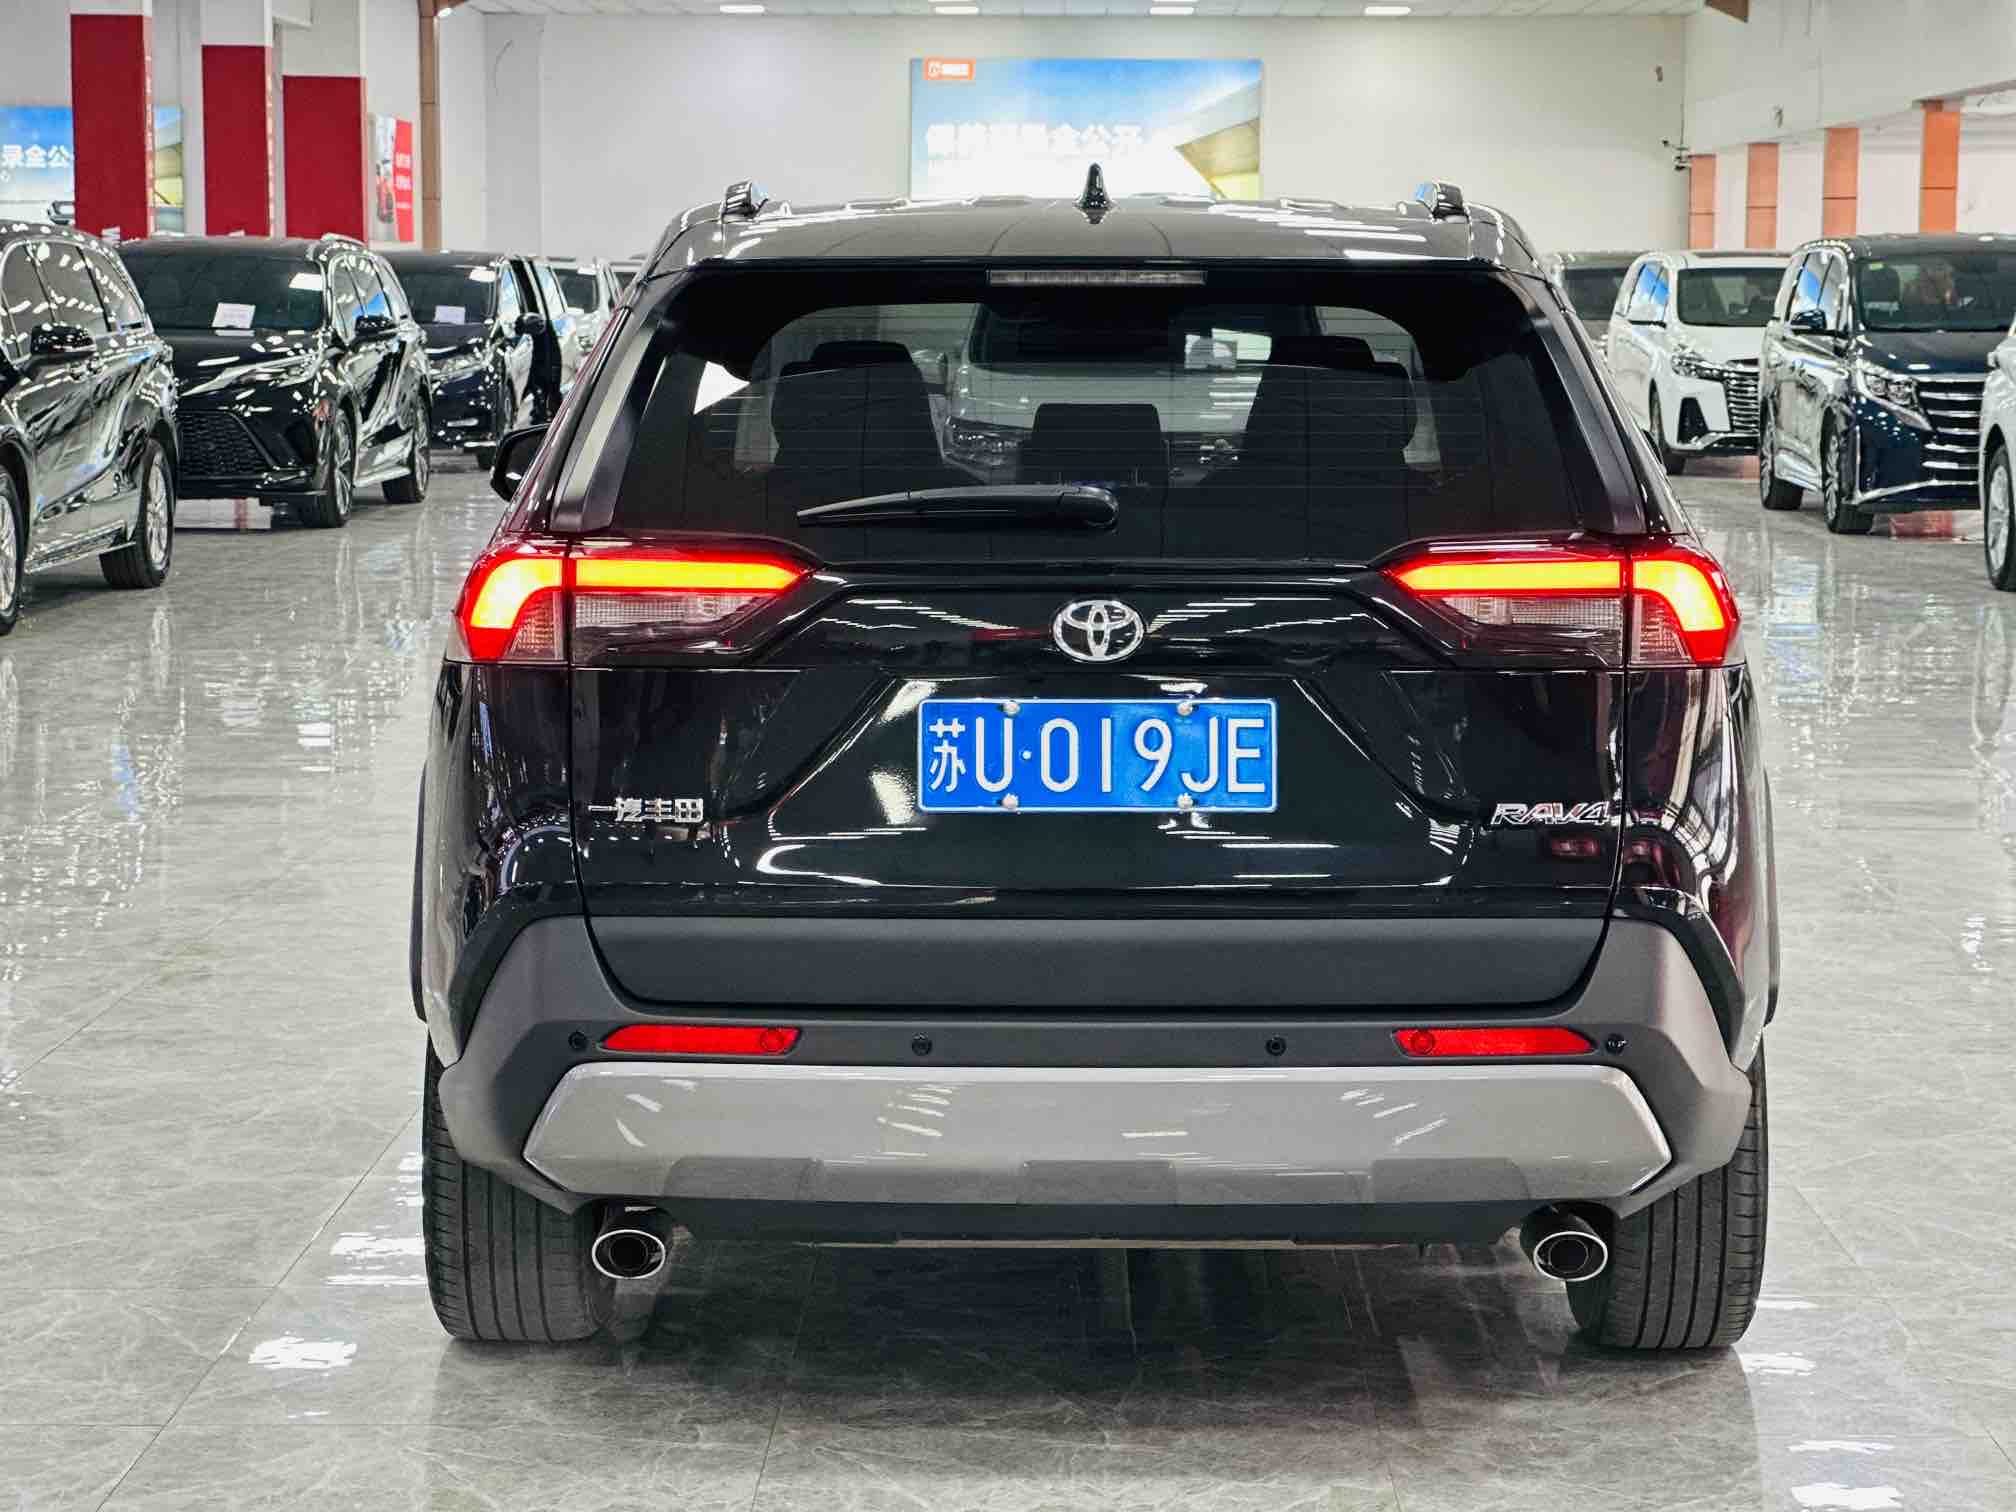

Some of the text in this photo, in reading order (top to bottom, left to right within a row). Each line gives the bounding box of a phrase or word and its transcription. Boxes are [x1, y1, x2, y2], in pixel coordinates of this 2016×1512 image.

[928, 717, 1266, 793] 苏U·019JE
[588, 798, 704, 823] 一汽丰田
[1491, 801, 1611, 826] RAV4
